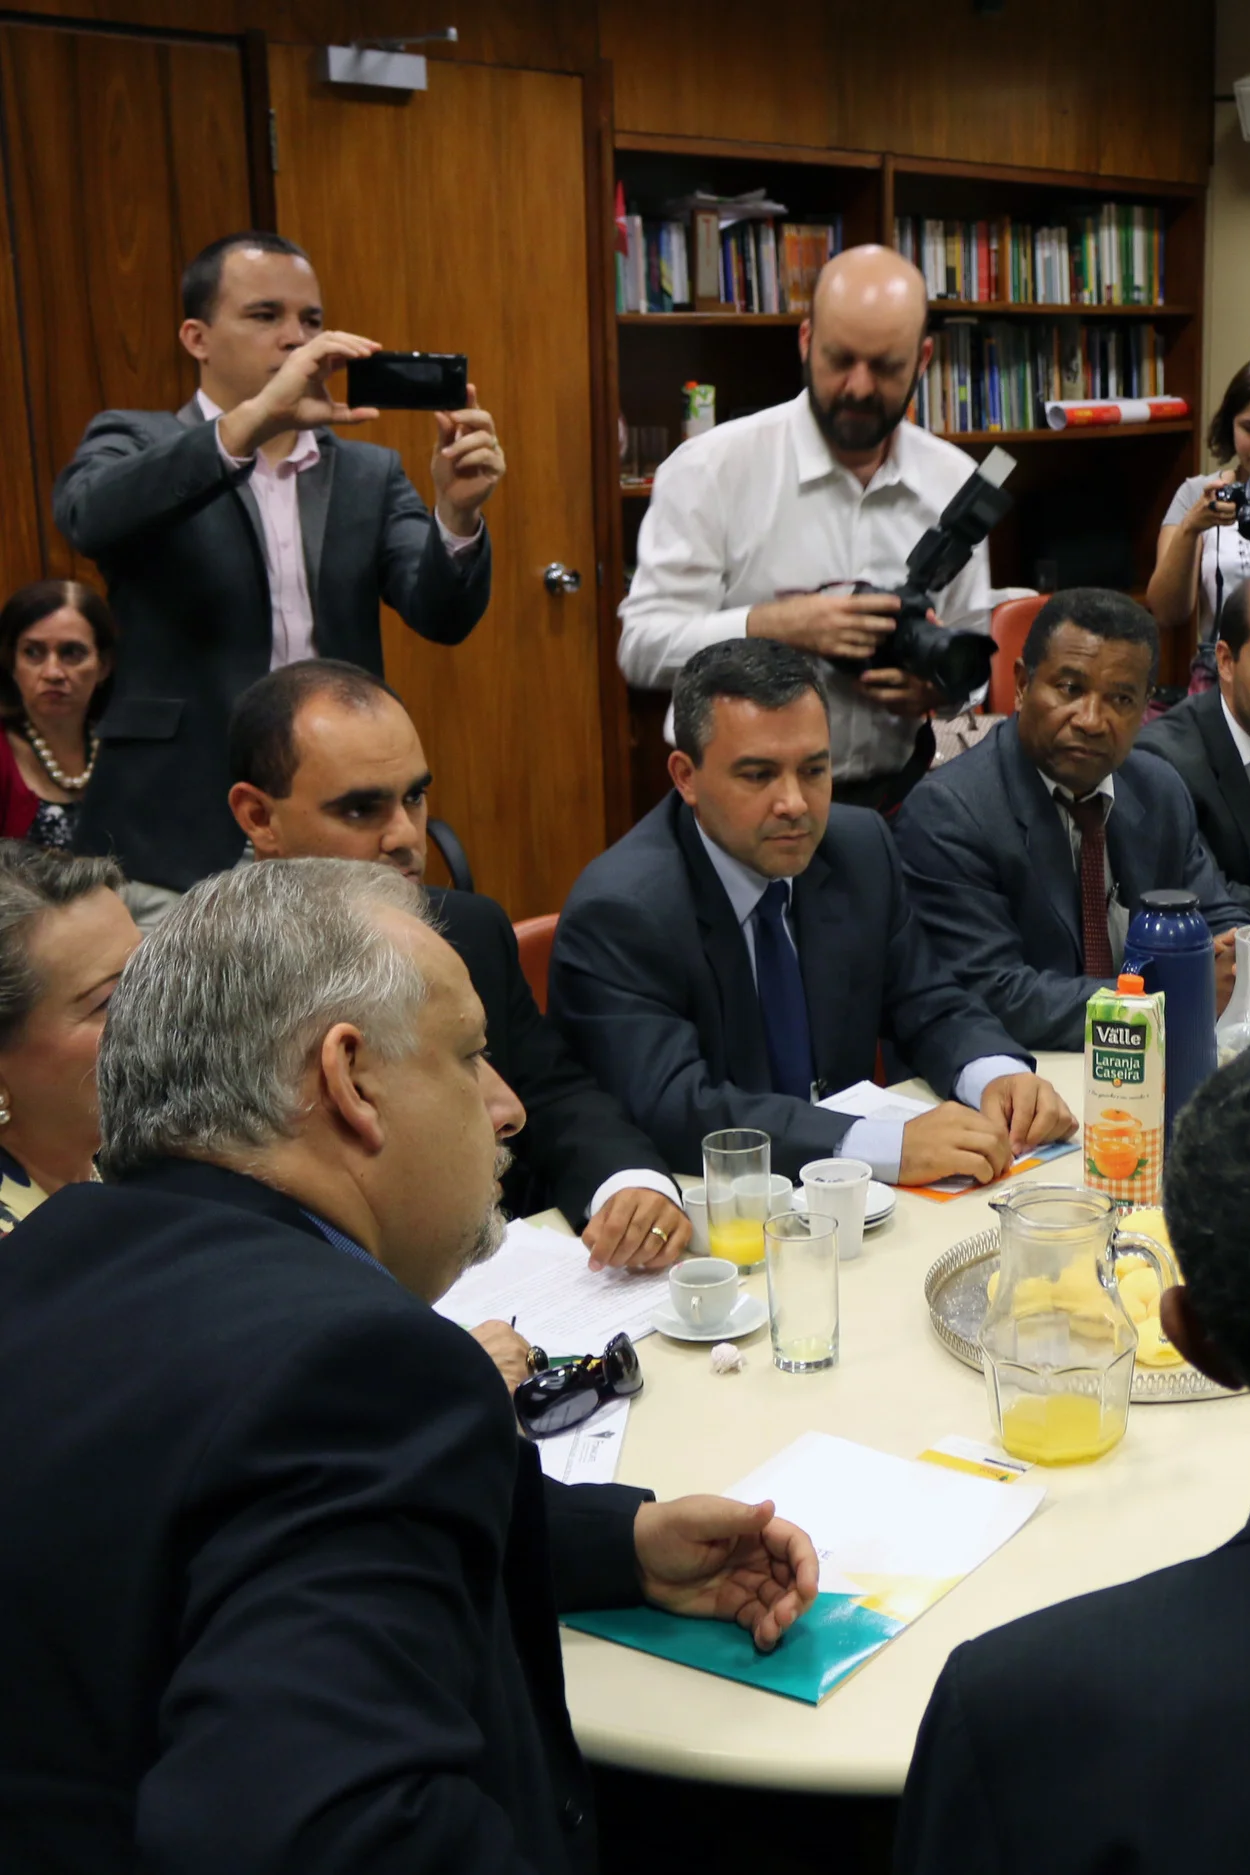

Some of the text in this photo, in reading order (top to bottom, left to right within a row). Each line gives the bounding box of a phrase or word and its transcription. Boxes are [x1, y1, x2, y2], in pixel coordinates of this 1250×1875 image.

[1096, 1025, 1141, 1045] Valle
[1095, 1052, 1140, 1071] Laranja
[1095, 1066, 1140, 1080] Caseira
